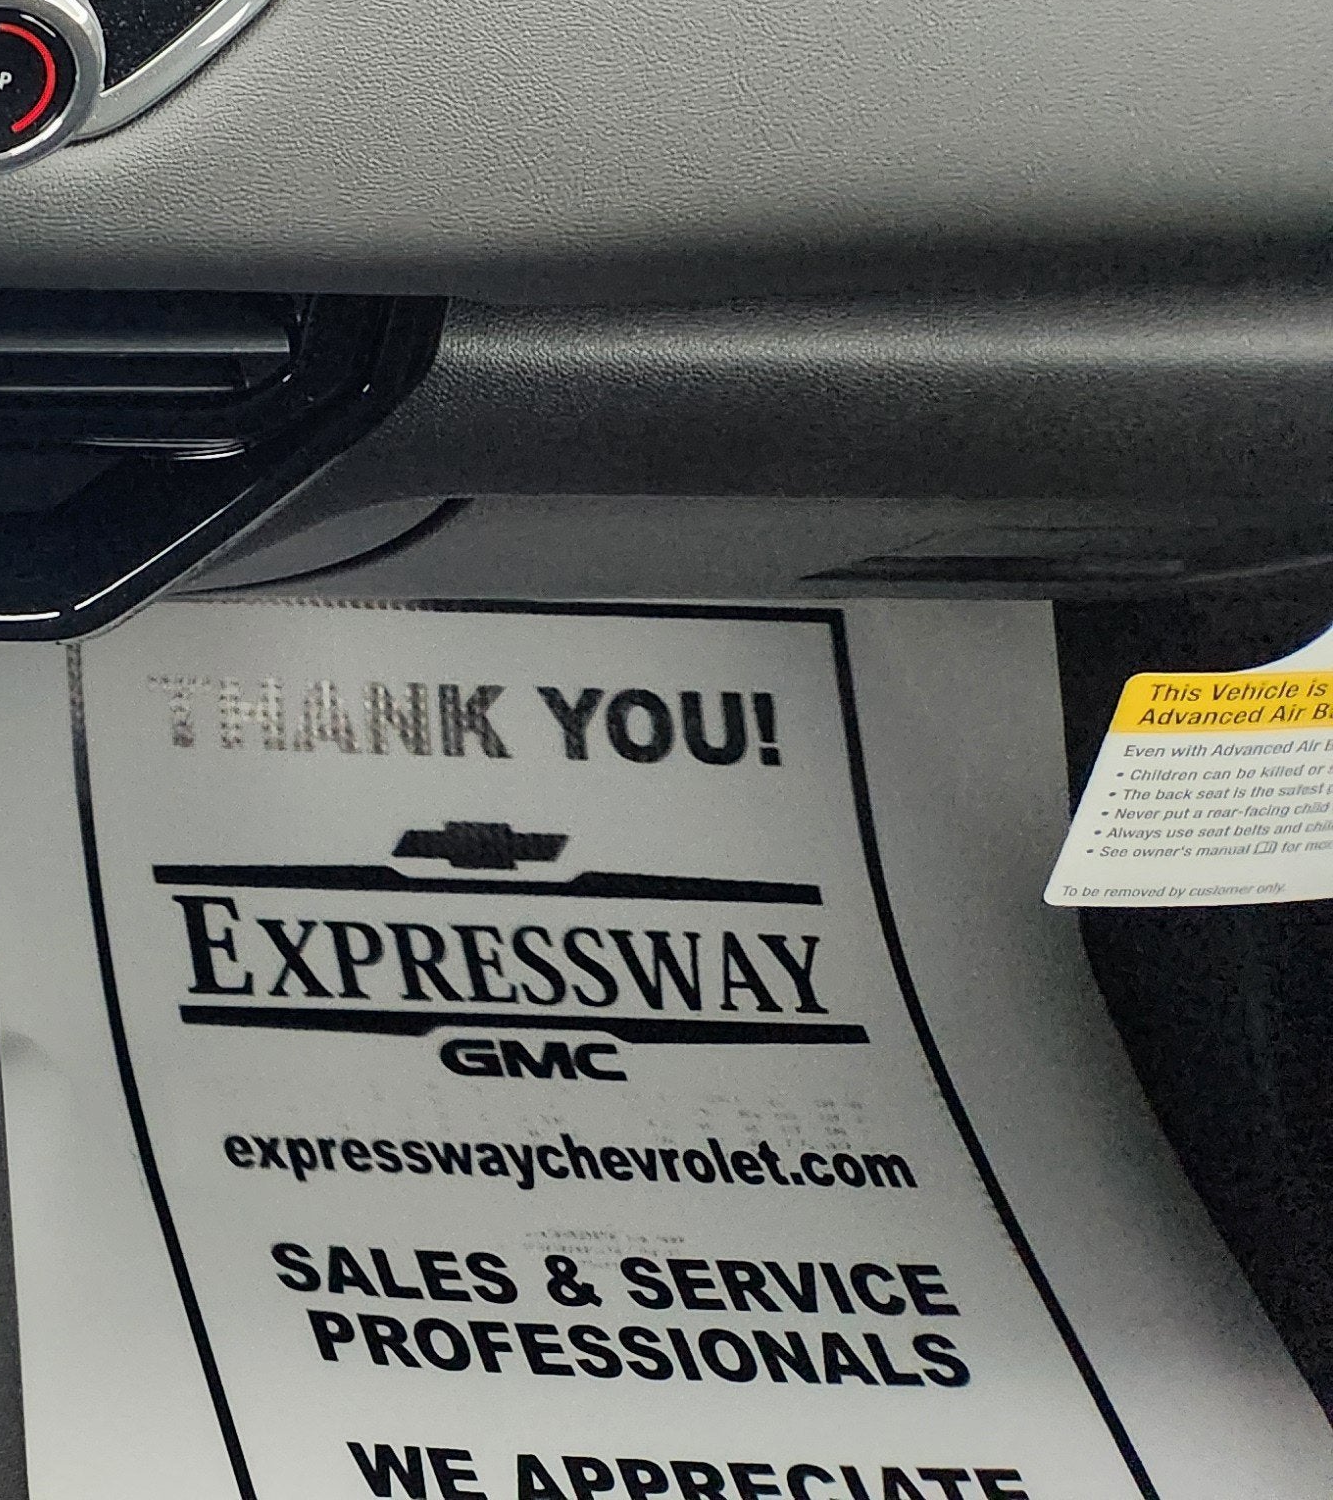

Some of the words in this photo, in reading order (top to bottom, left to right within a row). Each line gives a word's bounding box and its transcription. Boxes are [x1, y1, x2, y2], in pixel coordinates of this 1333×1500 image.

[1151, 683, 1202, 702] This
[1212, 681, 1300, 701] Vehicle
[1306, 678, 1329, 698] is
[147, 672, 513, 761] THANK
[534, 685, 784, 768] YOU!
[1138, 706, 1265, 726] Advanced
[1269, 704, 1307, 722] Air
[1123, 744, 1165, 758] Even
[1171, 744, 1208, 758] with
[1211, 740, 1294, 757] Advanced
[1295, 738, 1322, 753] Air
[1130, 768, 1198, 782] Children
[1202, 769, 1231, 781] can
[1236, 767, 1256, 780] be
[1259, 764, 1305, 779] killed
[1307, 764, 1326, 776] or
[1123, 788, 1151, 800] The
[1155, 788, 1192, 800] back
[1196, 787, 1230, 799] seat
[1233, 787, 1246, 798] is
[1250, 785, 1274, 798] the
[1114, 807, 1161, 820] Never
[1162, 807, 1190, 821] put
[1192, 809, 1202, 819] a
[1206, 803, 1290, 819] rear-facing
[1106, 826, 1162, 840] Always
[1166, 828, 1194, 839] use
[1197, 826, 1230, 838] seat
[1233, 824, 1271, 837] belts
[1273, 821, 1303, 835] and
[1100, 845, 1128, 858] See
[1133, 844, 1192, 858] owner's
[1195, 842, 1251, 856] manual
[1062, 885, 1078, 898] To
[1082, 885, 1100, 898] be
[1103, 885, 1166, 898] removed
[1168, 885, 1186, 900] by
[171, 893, 830, 1016] EXPRESSWAY
[439, 1037, 629, 1083] GMC
[223, 1129, 918, 1190] expresswaychevrolet.com
[269, 1241, 519, 1307] SALES
[545, 1255, 603, 1309] &
[625, 1257, 961, 1319] SERVICE
[304, 1308, 974, 1392] PROFESSIONALS
[345, 1441, 490, 1500] WE
